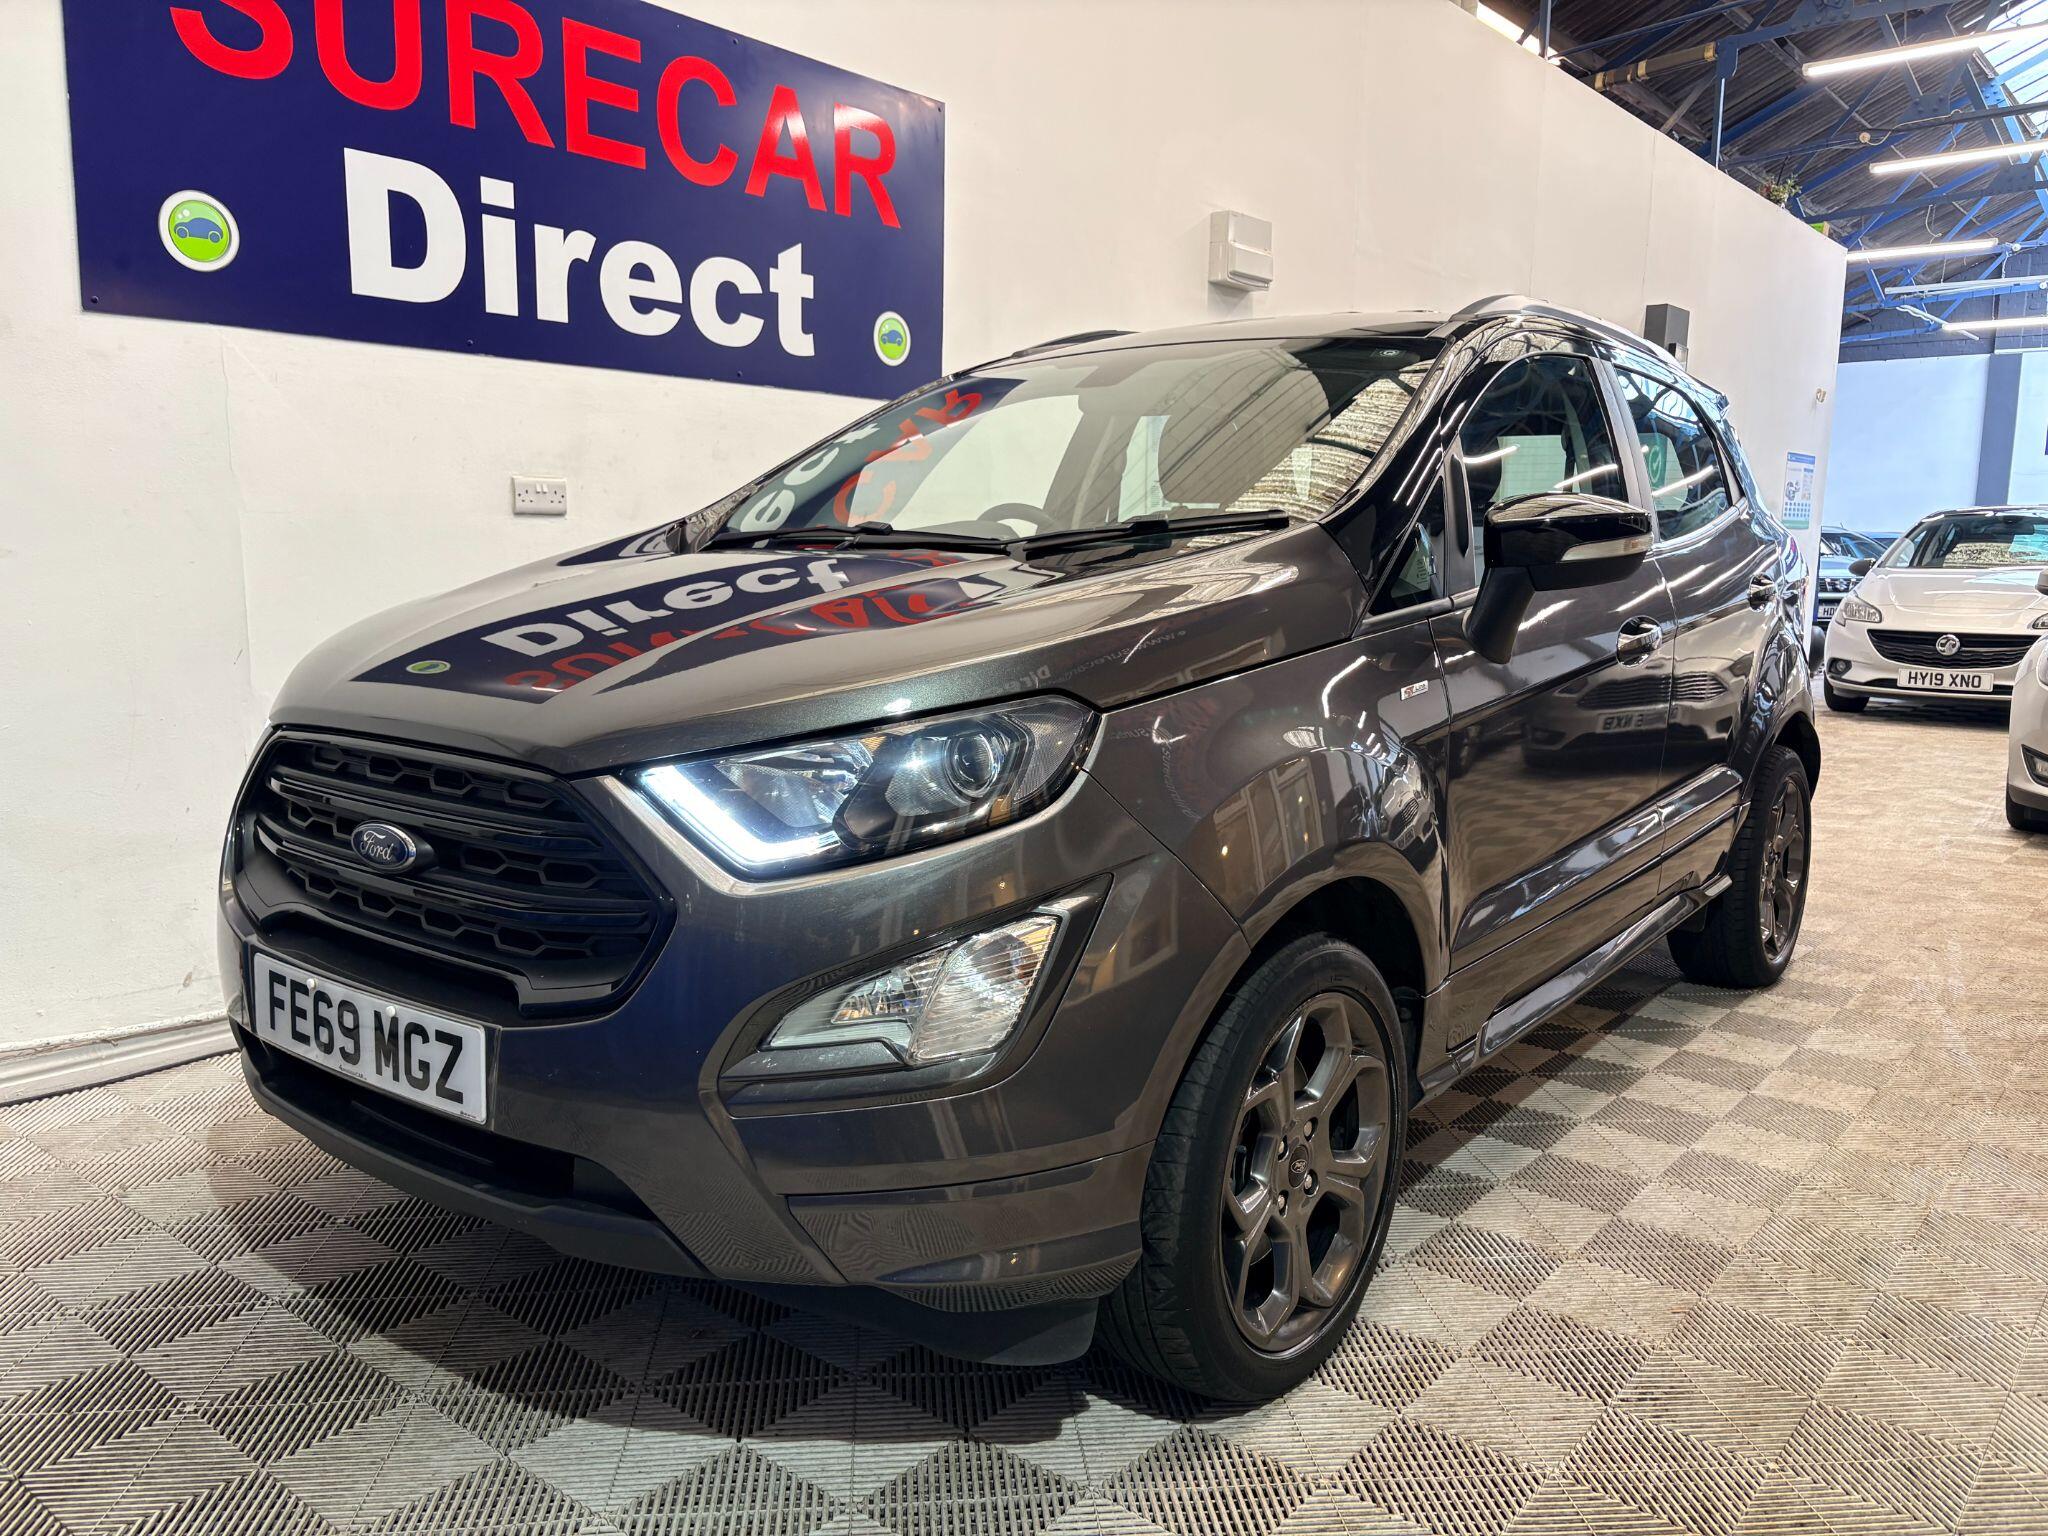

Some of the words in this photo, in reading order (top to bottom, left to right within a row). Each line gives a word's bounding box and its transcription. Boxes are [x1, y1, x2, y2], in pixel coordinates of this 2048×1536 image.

[343, 147, 815, 358] Direct
[1907, 671, 1944, 686] HY19
[1949, 673, 1982, 688] XNO
[360, 830, 395, 861] Ford
[268, 968, 361, 1066] FE69
[373, 1009, 464, 1104] MGZ
